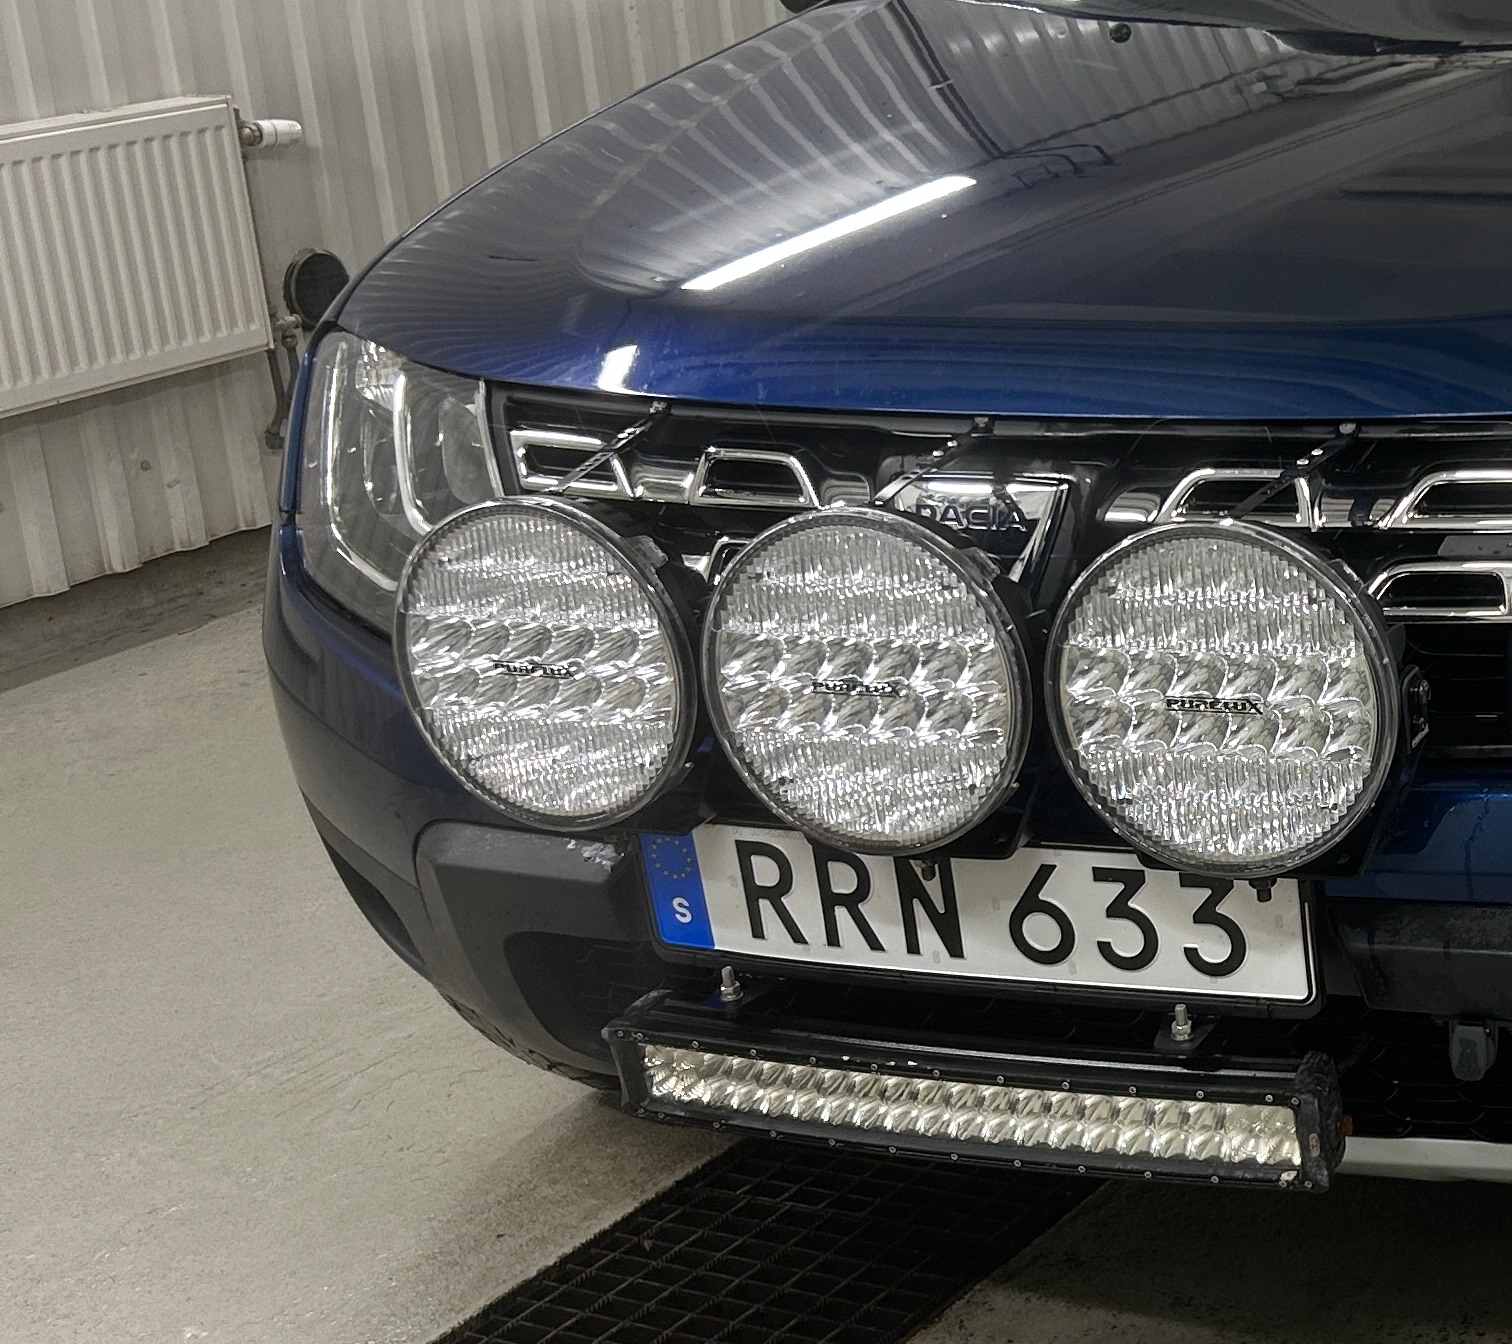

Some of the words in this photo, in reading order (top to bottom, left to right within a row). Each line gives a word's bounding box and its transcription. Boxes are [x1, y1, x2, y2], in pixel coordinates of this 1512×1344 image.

[672, 897, 692, 924] S
[734, 839, 966, 959] RRN
[1008, 863, 1248, 978] 633
